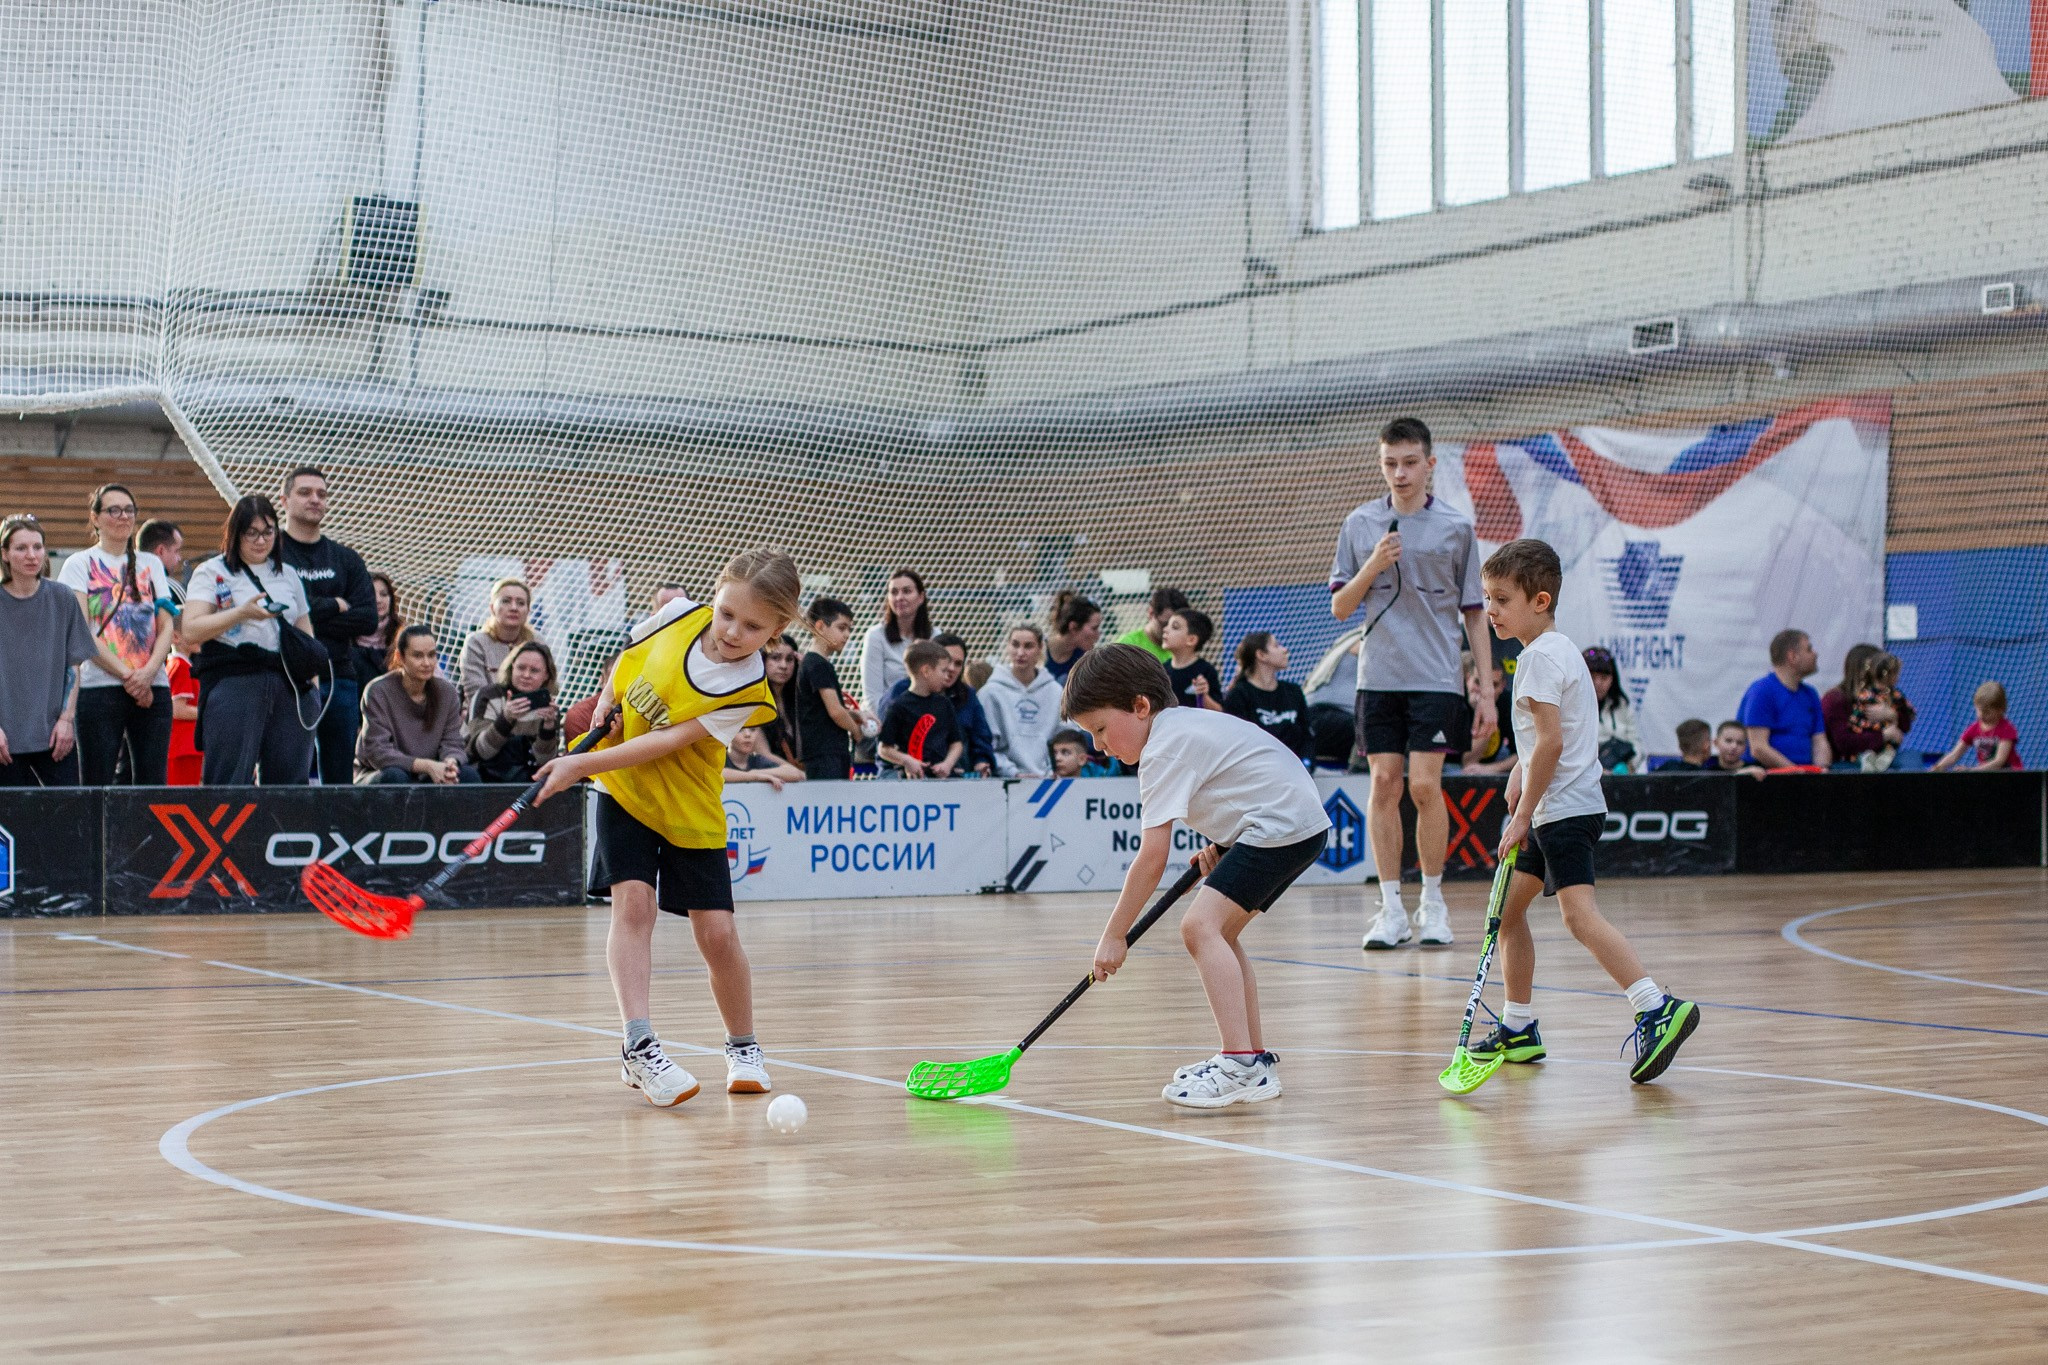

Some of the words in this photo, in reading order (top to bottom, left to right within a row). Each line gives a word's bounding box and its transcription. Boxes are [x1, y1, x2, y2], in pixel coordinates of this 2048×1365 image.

[786, 804, 961, 834] МИНСПОРТ
[1086, 798, 1142, 820] Floor
[730, 827, 756, 840] ЛЕТ
[1112, 830, 1141, 851] No
[1599, 810, 1709, 841] DOG
[265, 831, 546, 866] OXDOG
[811, 842, 936, 872] РОССИИ
